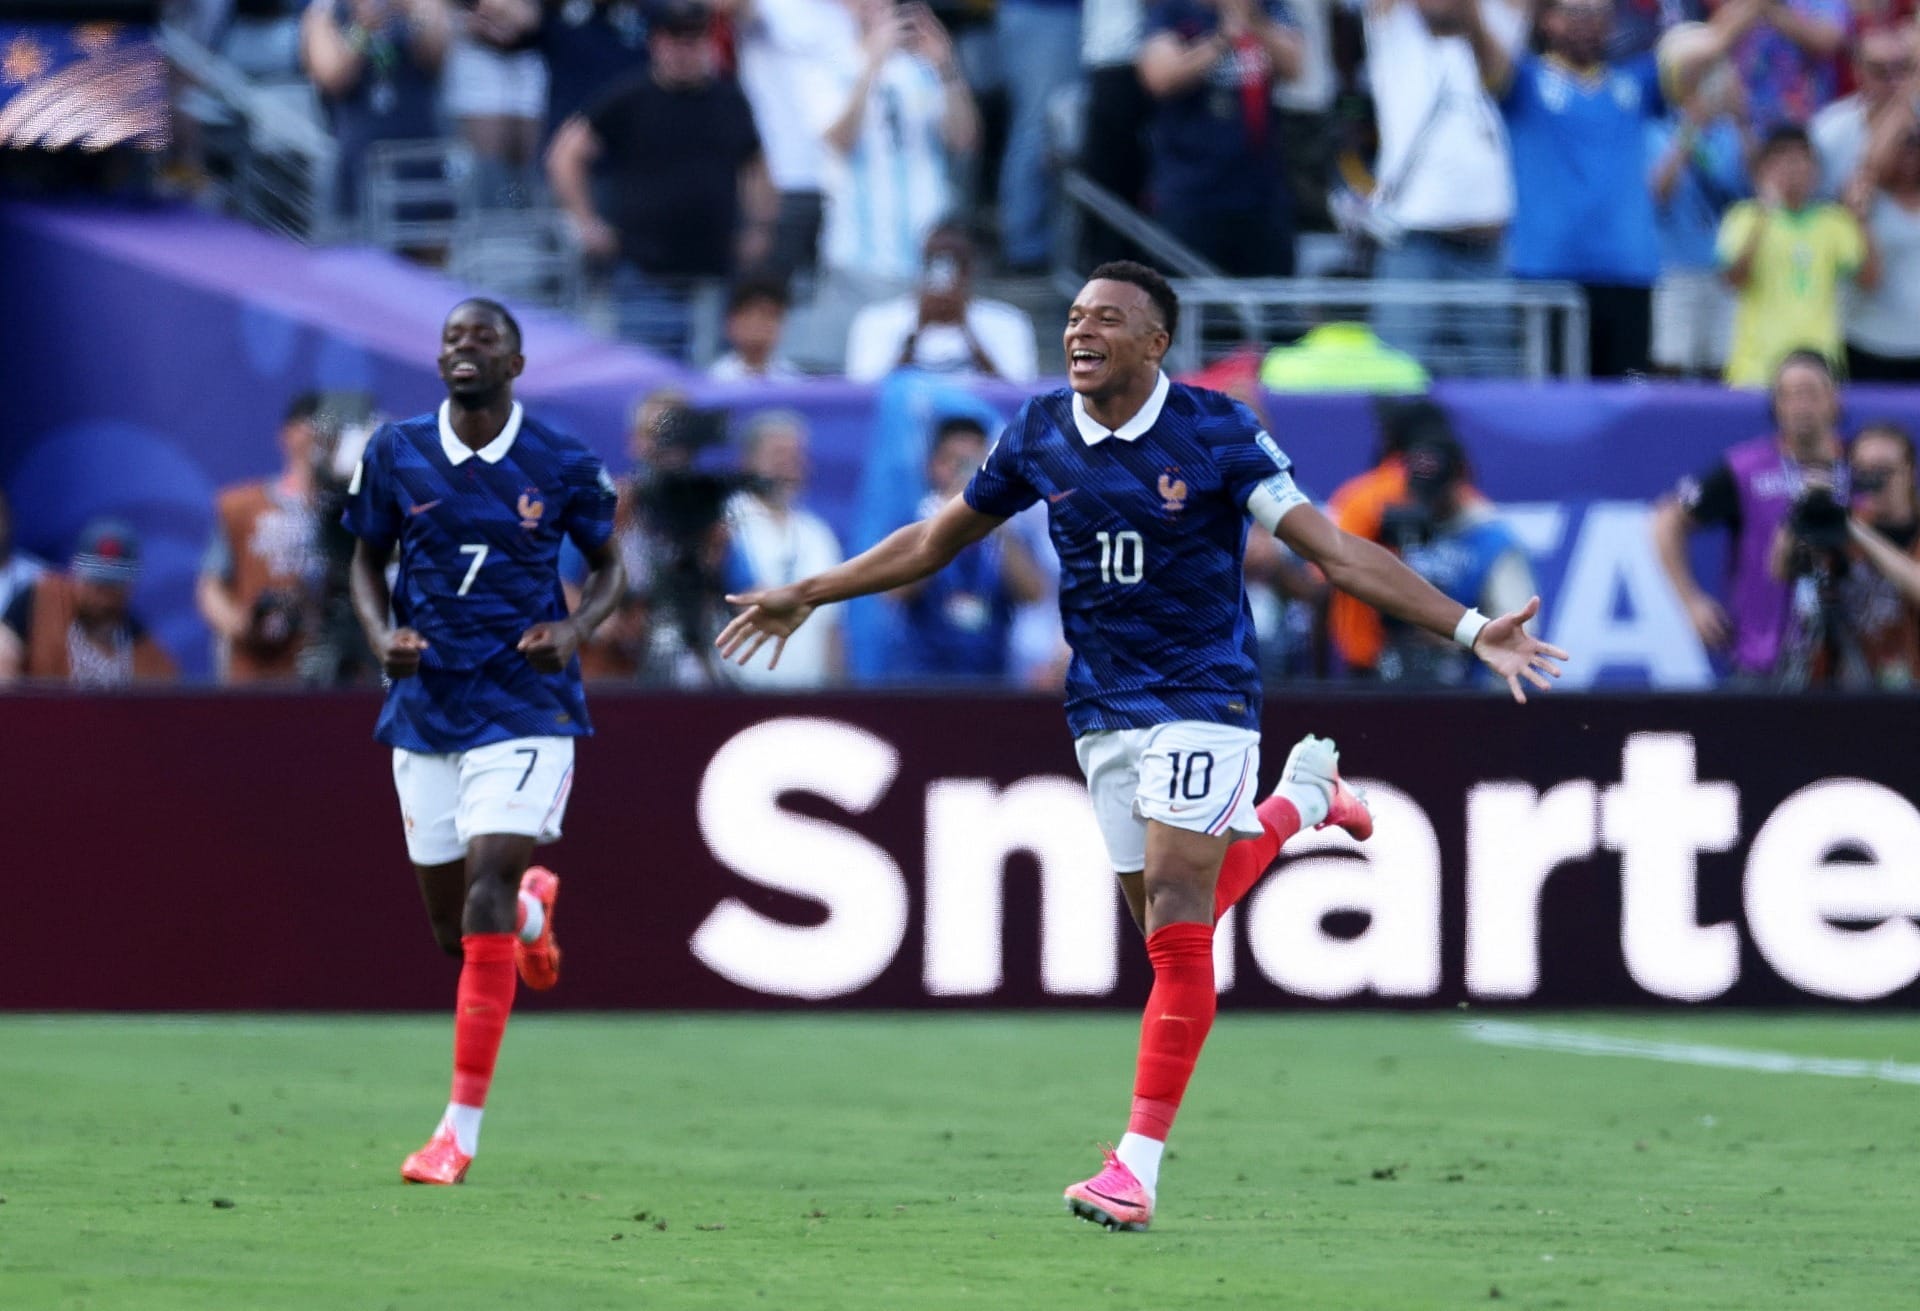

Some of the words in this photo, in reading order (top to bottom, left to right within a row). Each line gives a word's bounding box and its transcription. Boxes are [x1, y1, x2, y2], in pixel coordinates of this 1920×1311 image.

[457, 544, 488, 596] 7
[1096, 530, 1143, 584] 10
[514, 748, 538, 792] 7
[1167, 751, 1214, 800] 10
